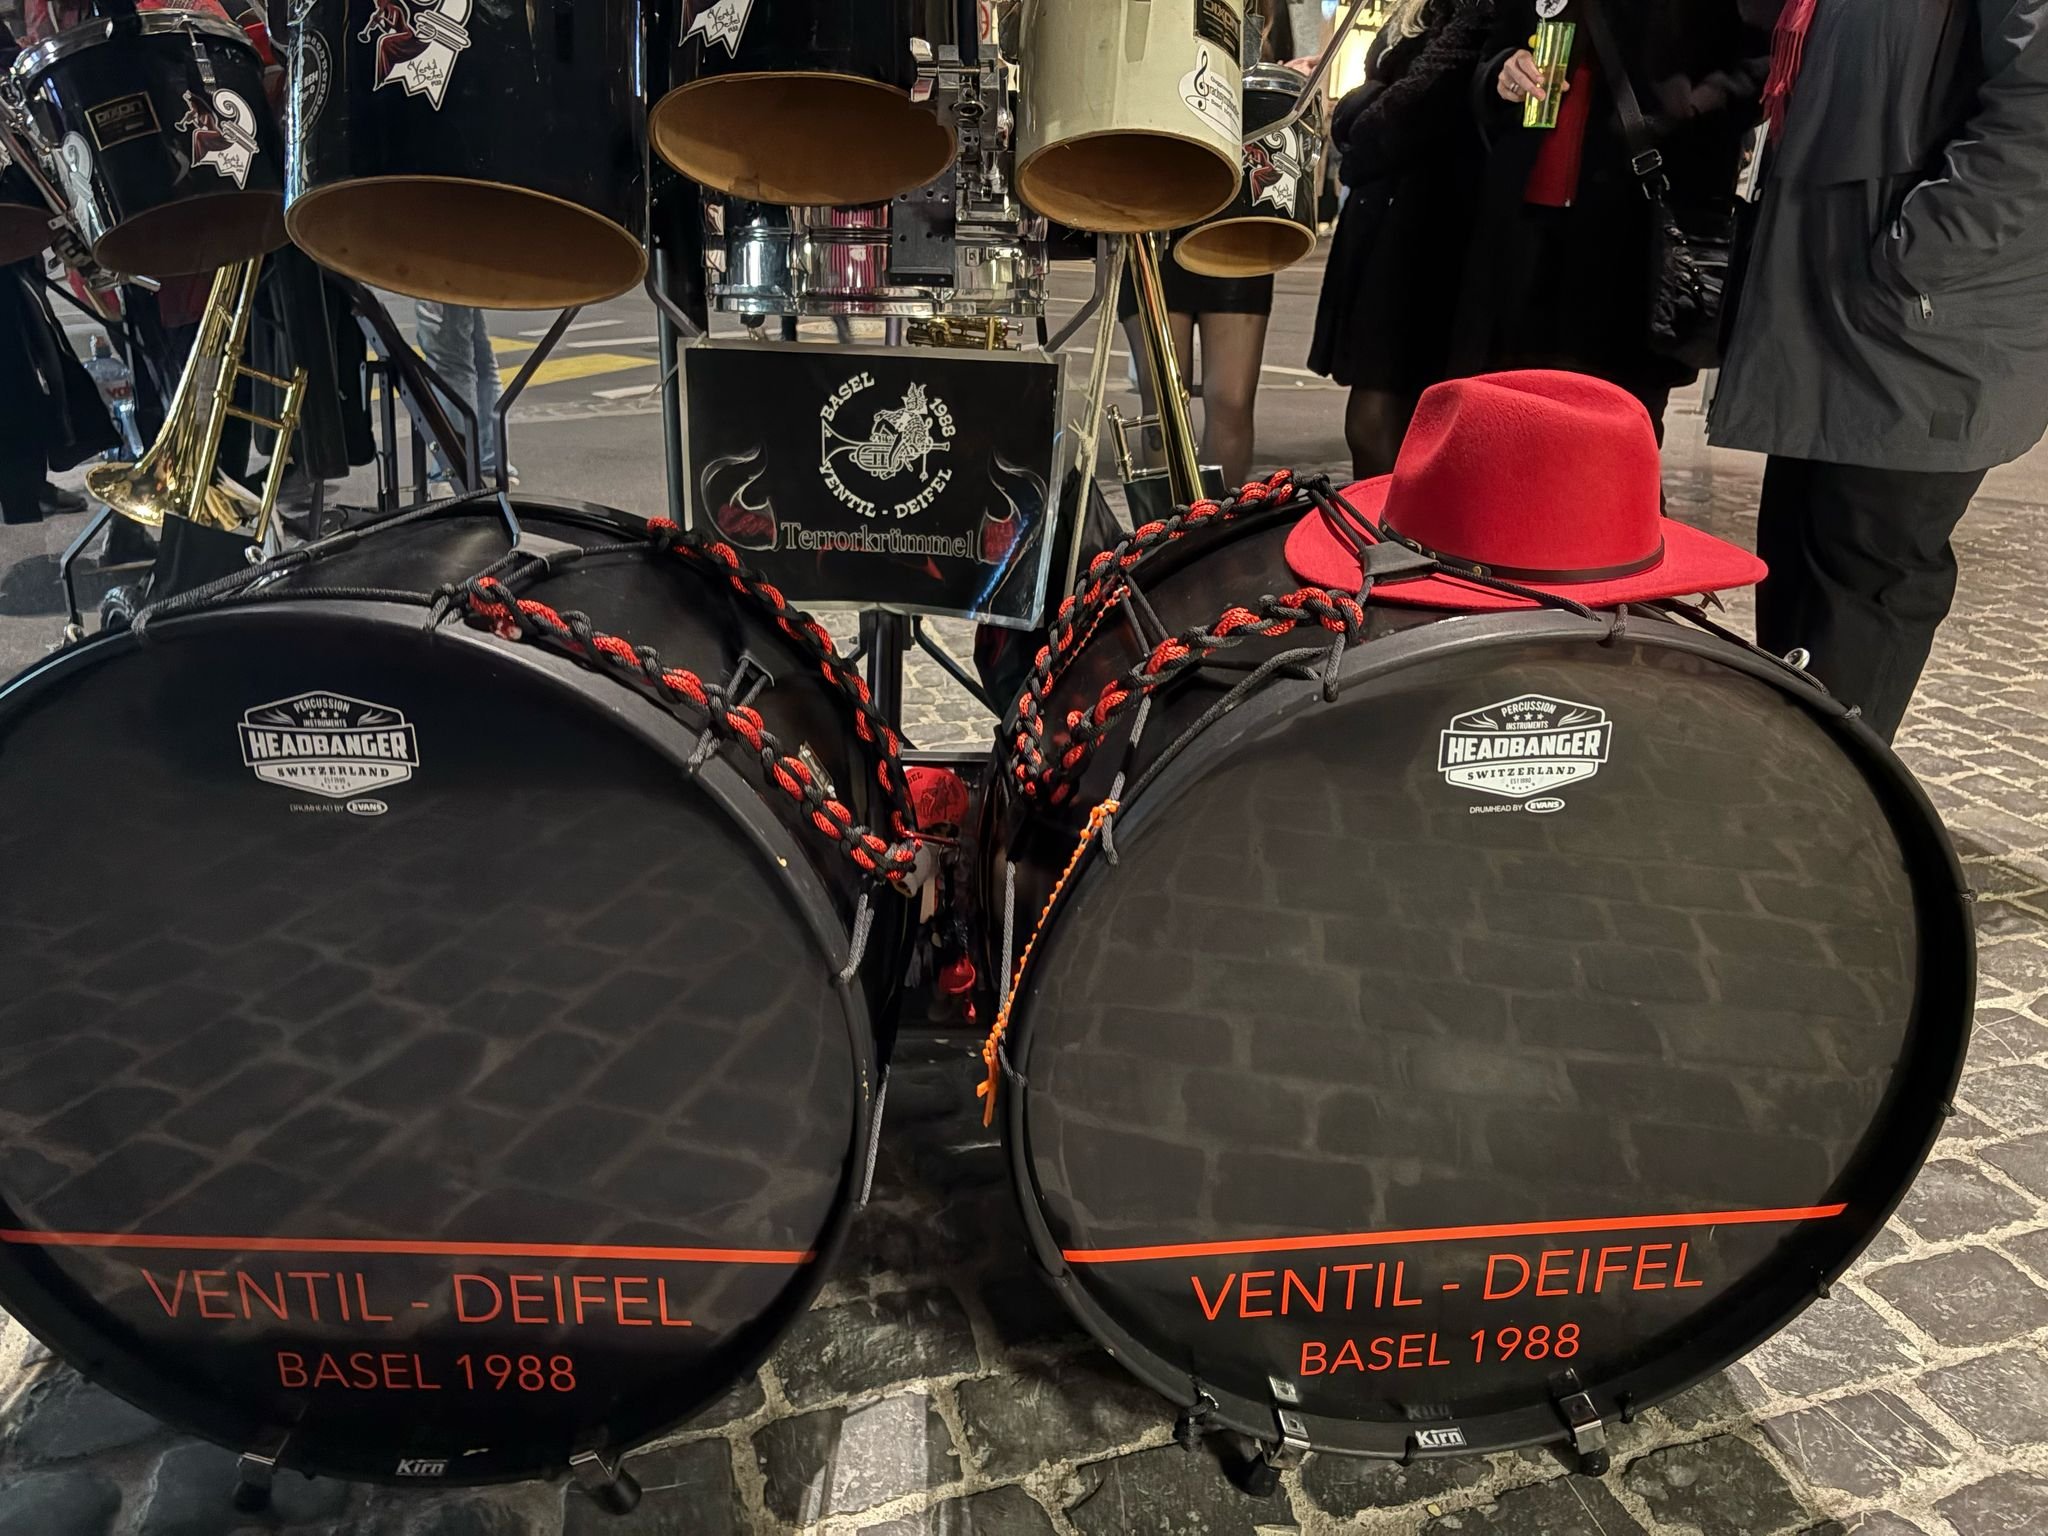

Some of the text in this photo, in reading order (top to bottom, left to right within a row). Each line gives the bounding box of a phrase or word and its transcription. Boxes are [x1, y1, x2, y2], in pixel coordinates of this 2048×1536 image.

[820, 371, 956, 437] BASEL 1988
[819, 461, 876, 518] VENTIL
[894, 469, 952, 519] DEIFEL
[780, 522, 974, 558] Terrorkrümmel
[293, 697, 350, 714] PERCUSSION
[1500, 701, 1557, 717] PERCUSSION
[303, 719, 347, 728] INSTRUMENTS
[1506, 721, 1549, 730] INSTRUMENTS
[249, 731, 408, 760] HEADBANGER
[1447, 730, 1602, 764] HEADBANGER
[278, 766, 390, 777] SWITZERLAND
[1467, 766, 1576, 780] SWITZERLAND
[1469, 801, 1560, 814] DRUMHEAD BY EVANS
[1191, 1261, 1422, 1321] VENTIL
[1484, 1242, 1703, 1301] DEIFEL
[142, 1268, 393, 1322] VENTIL
[453, 1273, 693, 1327] DEIFEL
[1300, 1323, 1581, 1376] BASEL 1988
[277, 1352, 577, 1392] BASEL 1988
[1415, 1427, 1463, 1448] Kirn
[396, 1459, 446, 1476] Kirn
